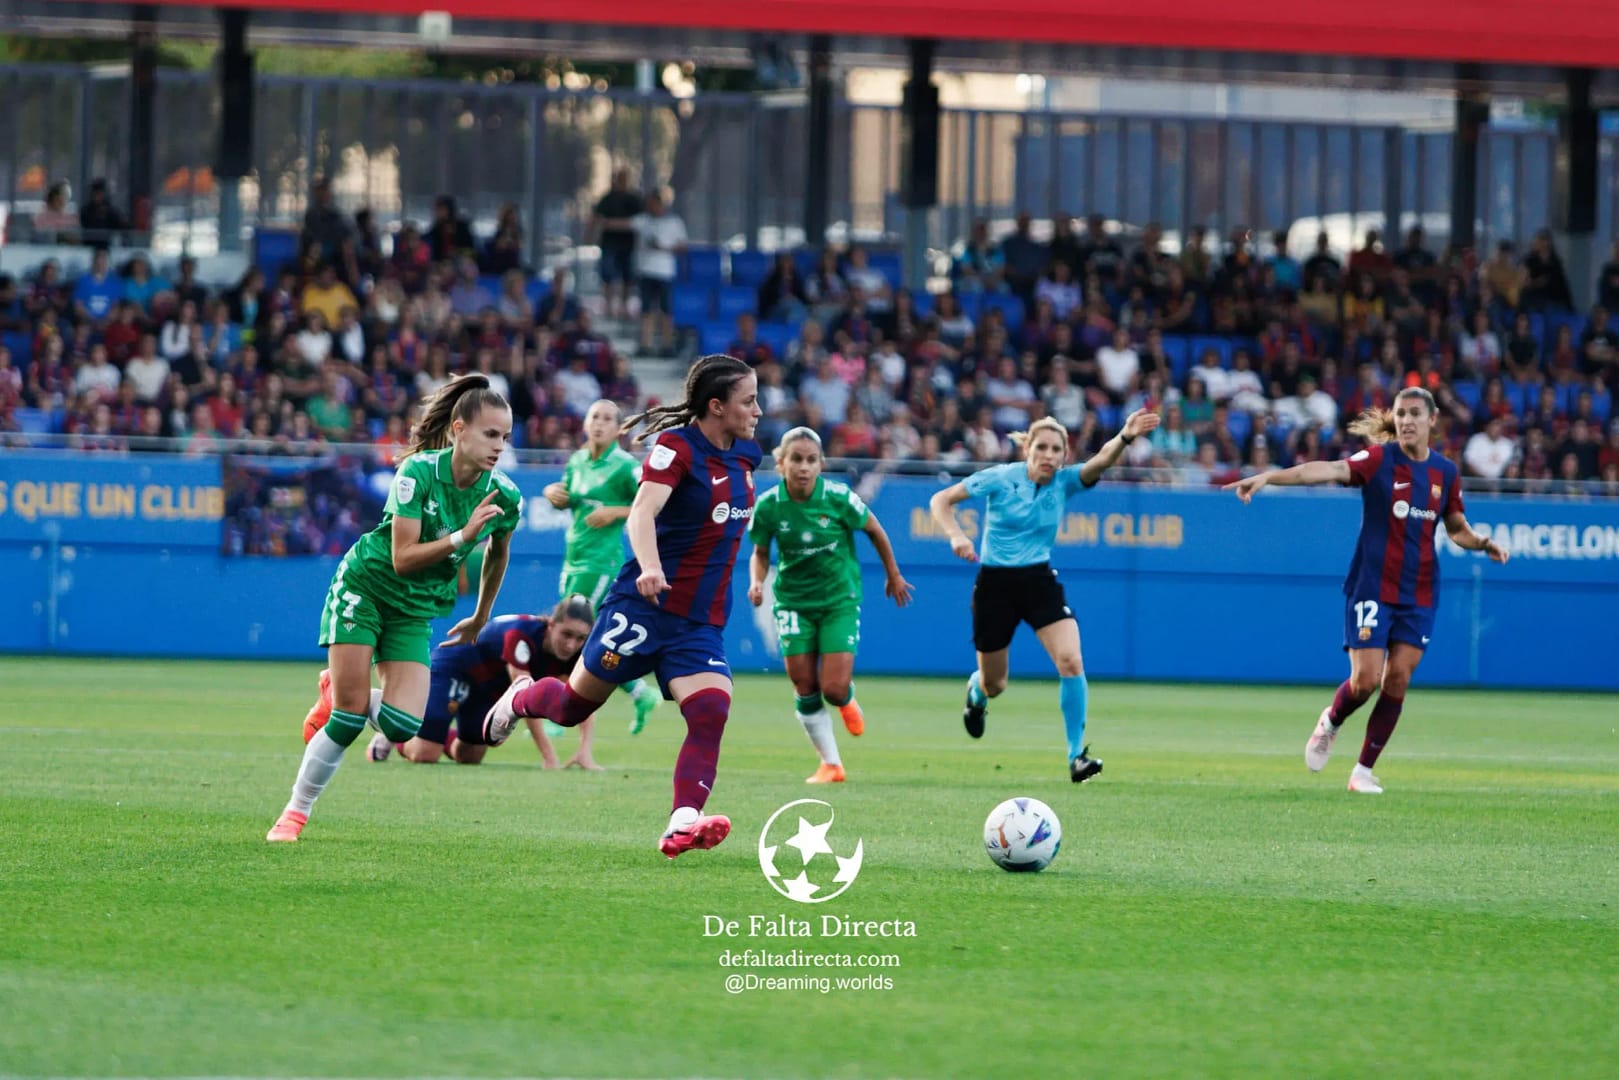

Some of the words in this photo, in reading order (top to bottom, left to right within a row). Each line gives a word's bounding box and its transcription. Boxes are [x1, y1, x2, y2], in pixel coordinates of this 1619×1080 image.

[13, 480, 81, 522] QUE
[86, 482, 136, 519] UN
[140, 483, 225, 521] CLUB
[1410, 506, 1436, 520] Spotify
[1103, 512, 1184, 549] CLUB
[342, 590, 362, 618] 7
[1354, 600, 1379, 628] 12
[600, 612, 648, 656] 22
[776, 610, 801, 635] 21
